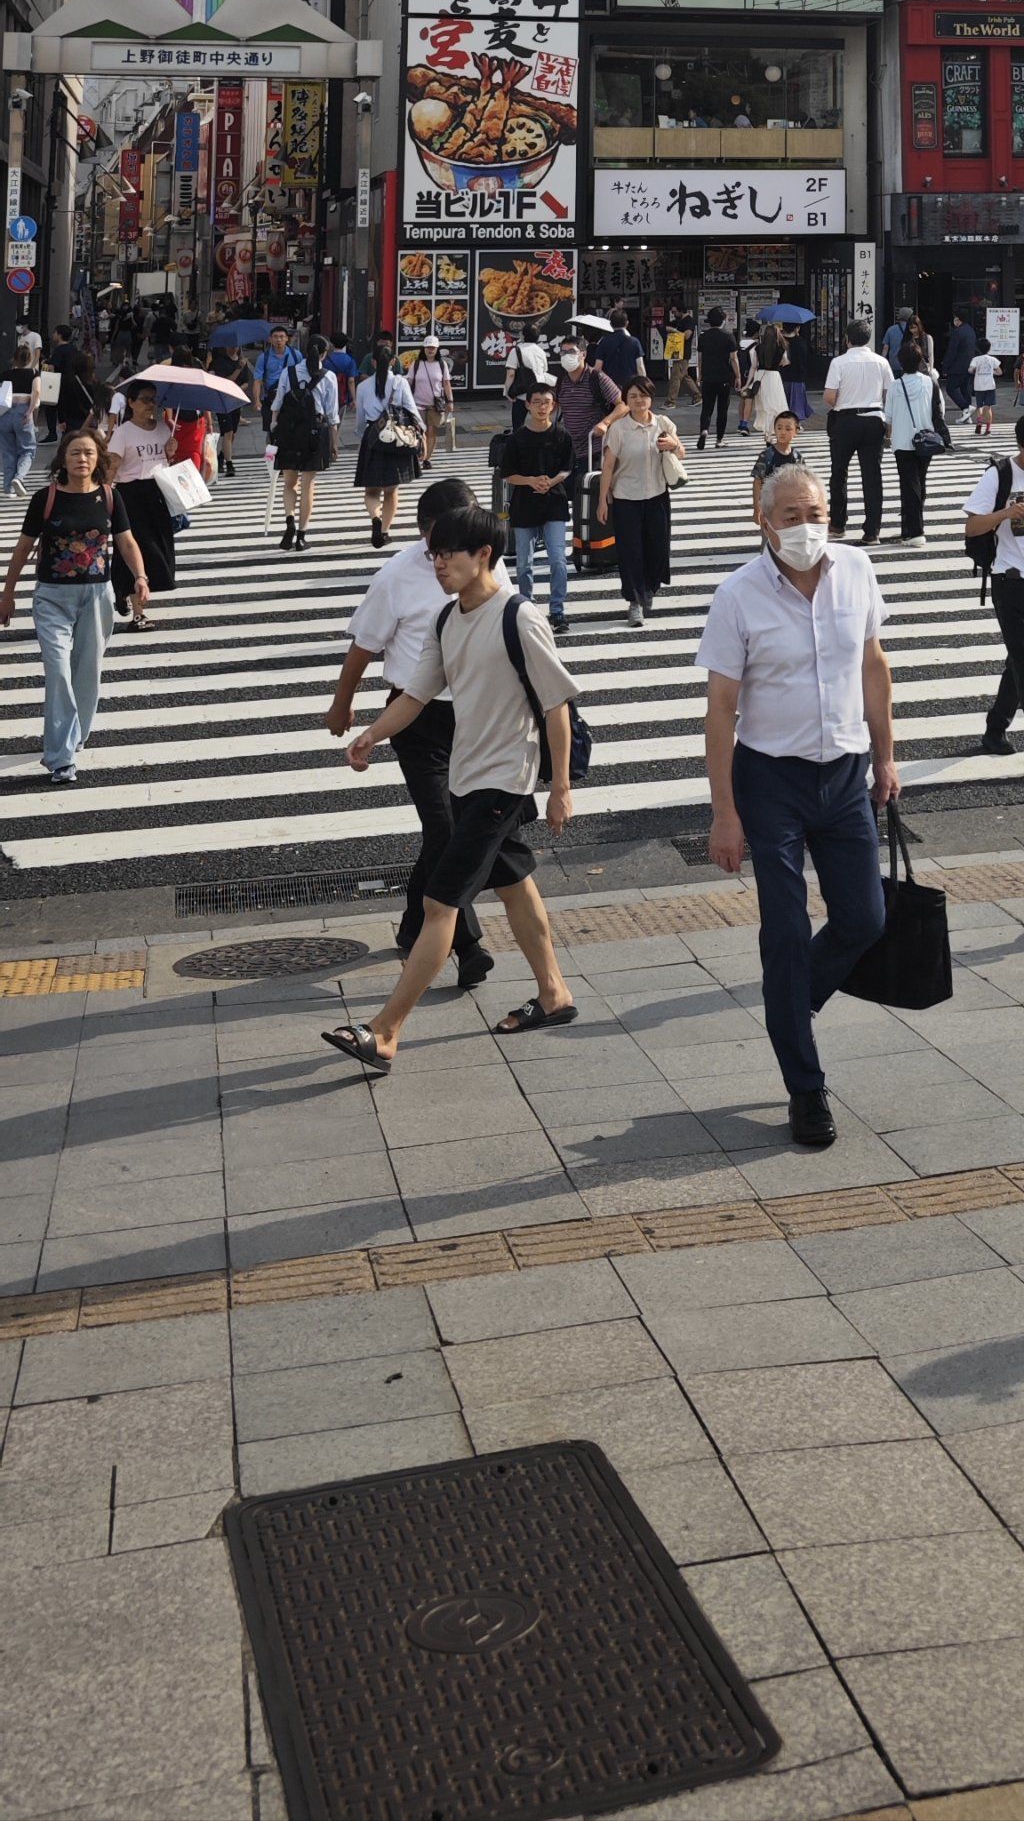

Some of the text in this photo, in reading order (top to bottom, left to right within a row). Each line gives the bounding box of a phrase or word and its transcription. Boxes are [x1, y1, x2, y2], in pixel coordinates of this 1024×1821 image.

[953, 23, 980, 36] The
[981, 24, 1020, 37] World
[121, 49, 274, 66] 上野御徒町中央通り
[945, 65, 981, 83] CRAFT
[222, 112, 238, 177] PIA
[611, 181, 648, 195] 牛たん
[806, 178, 829, 192] 2F
[415, 190, 537, 220] 当ビル1F
[631, 197, 661, 208] とろろ
[666, 180, 783, 225] ねぎし
[620, 211, 652, 225] 麦めし
[807, 213, 828, 227] B1
[403, 224, 575, 241] Tempura Tendon & Soba
[859, 251, 872, 259] B1
[860, 270, 870, 296] 牛たん
[856, 300, 873, 326] ねぎ
[136, 443, 163, 457] POL
